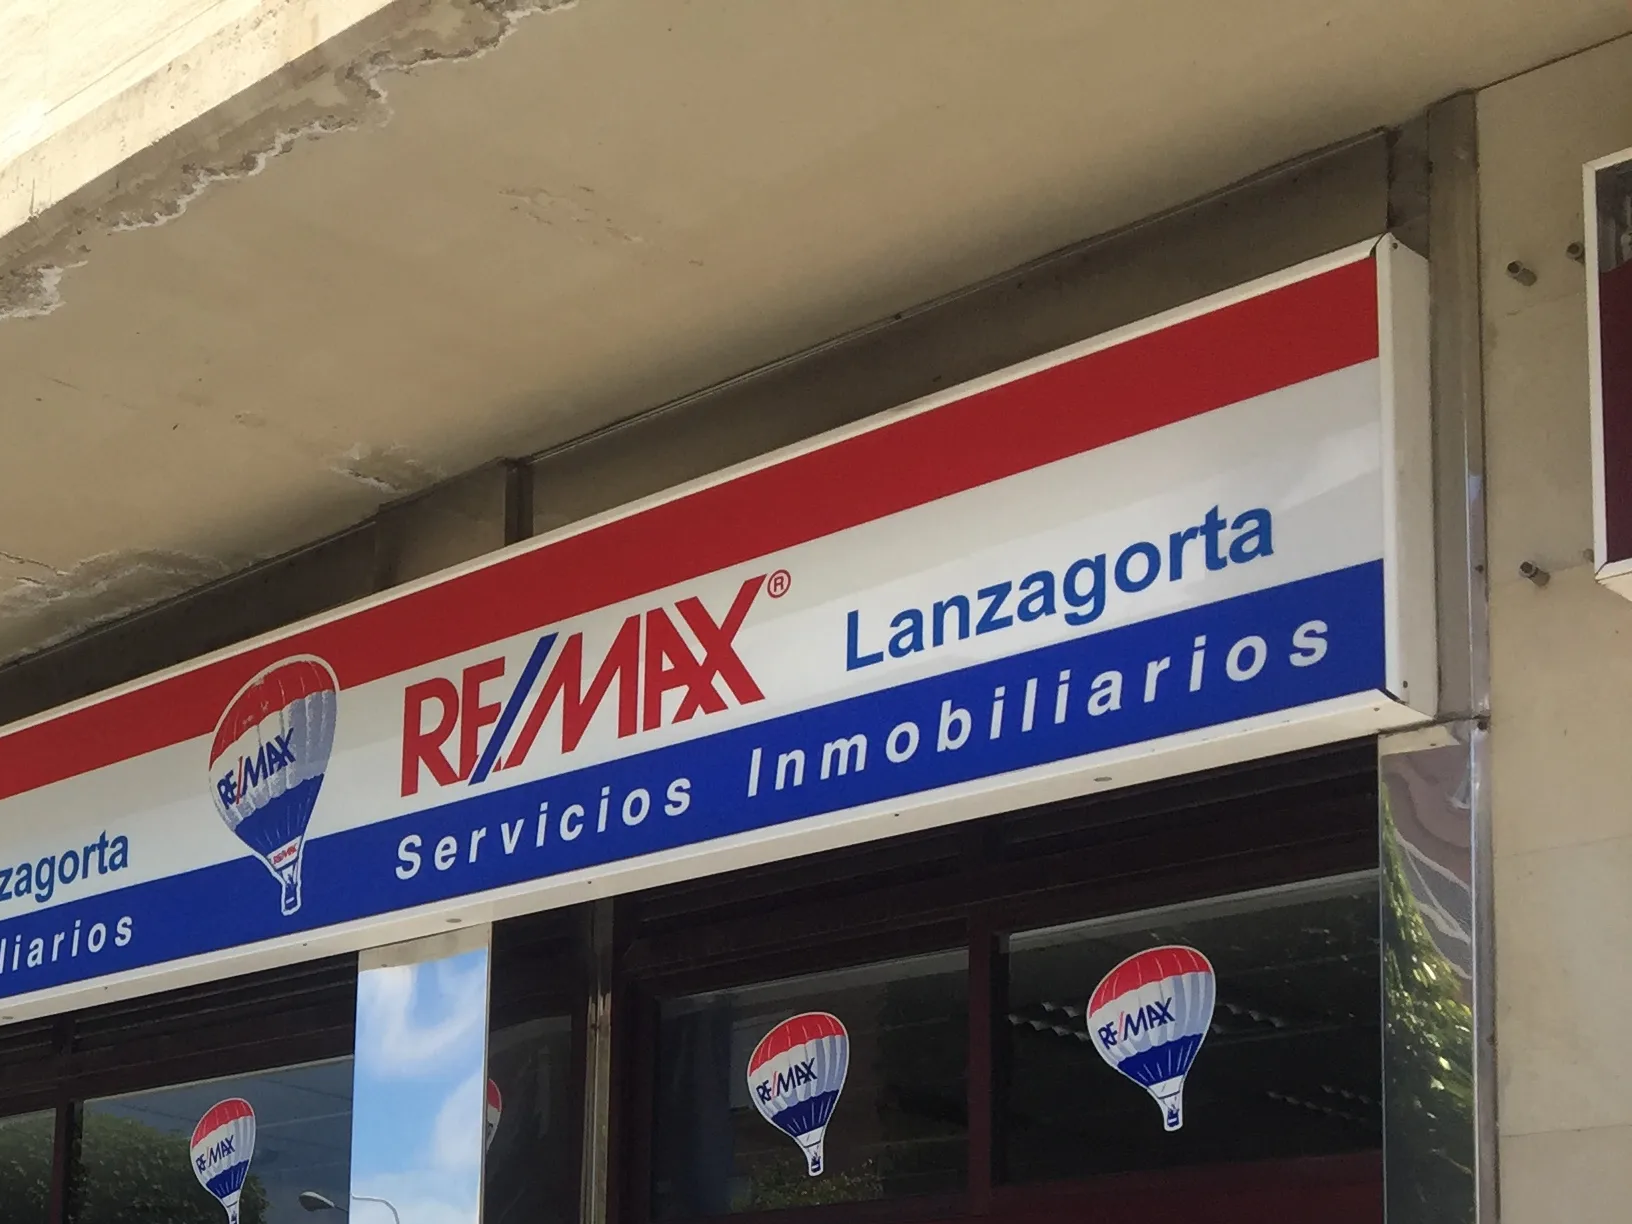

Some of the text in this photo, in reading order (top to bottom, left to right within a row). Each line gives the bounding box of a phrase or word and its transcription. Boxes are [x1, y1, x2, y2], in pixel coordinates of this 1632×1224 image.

[845, 504, 1274, 671] Lanzagorta
[217, 726, 296, 811] RE/MAX
[395, 618, 1329, 880] Servicios Inmobiliarios
[1097, 997, 1173, 1050] RE/MAX
[756, 1058, 817, 1102] RE/MAX
